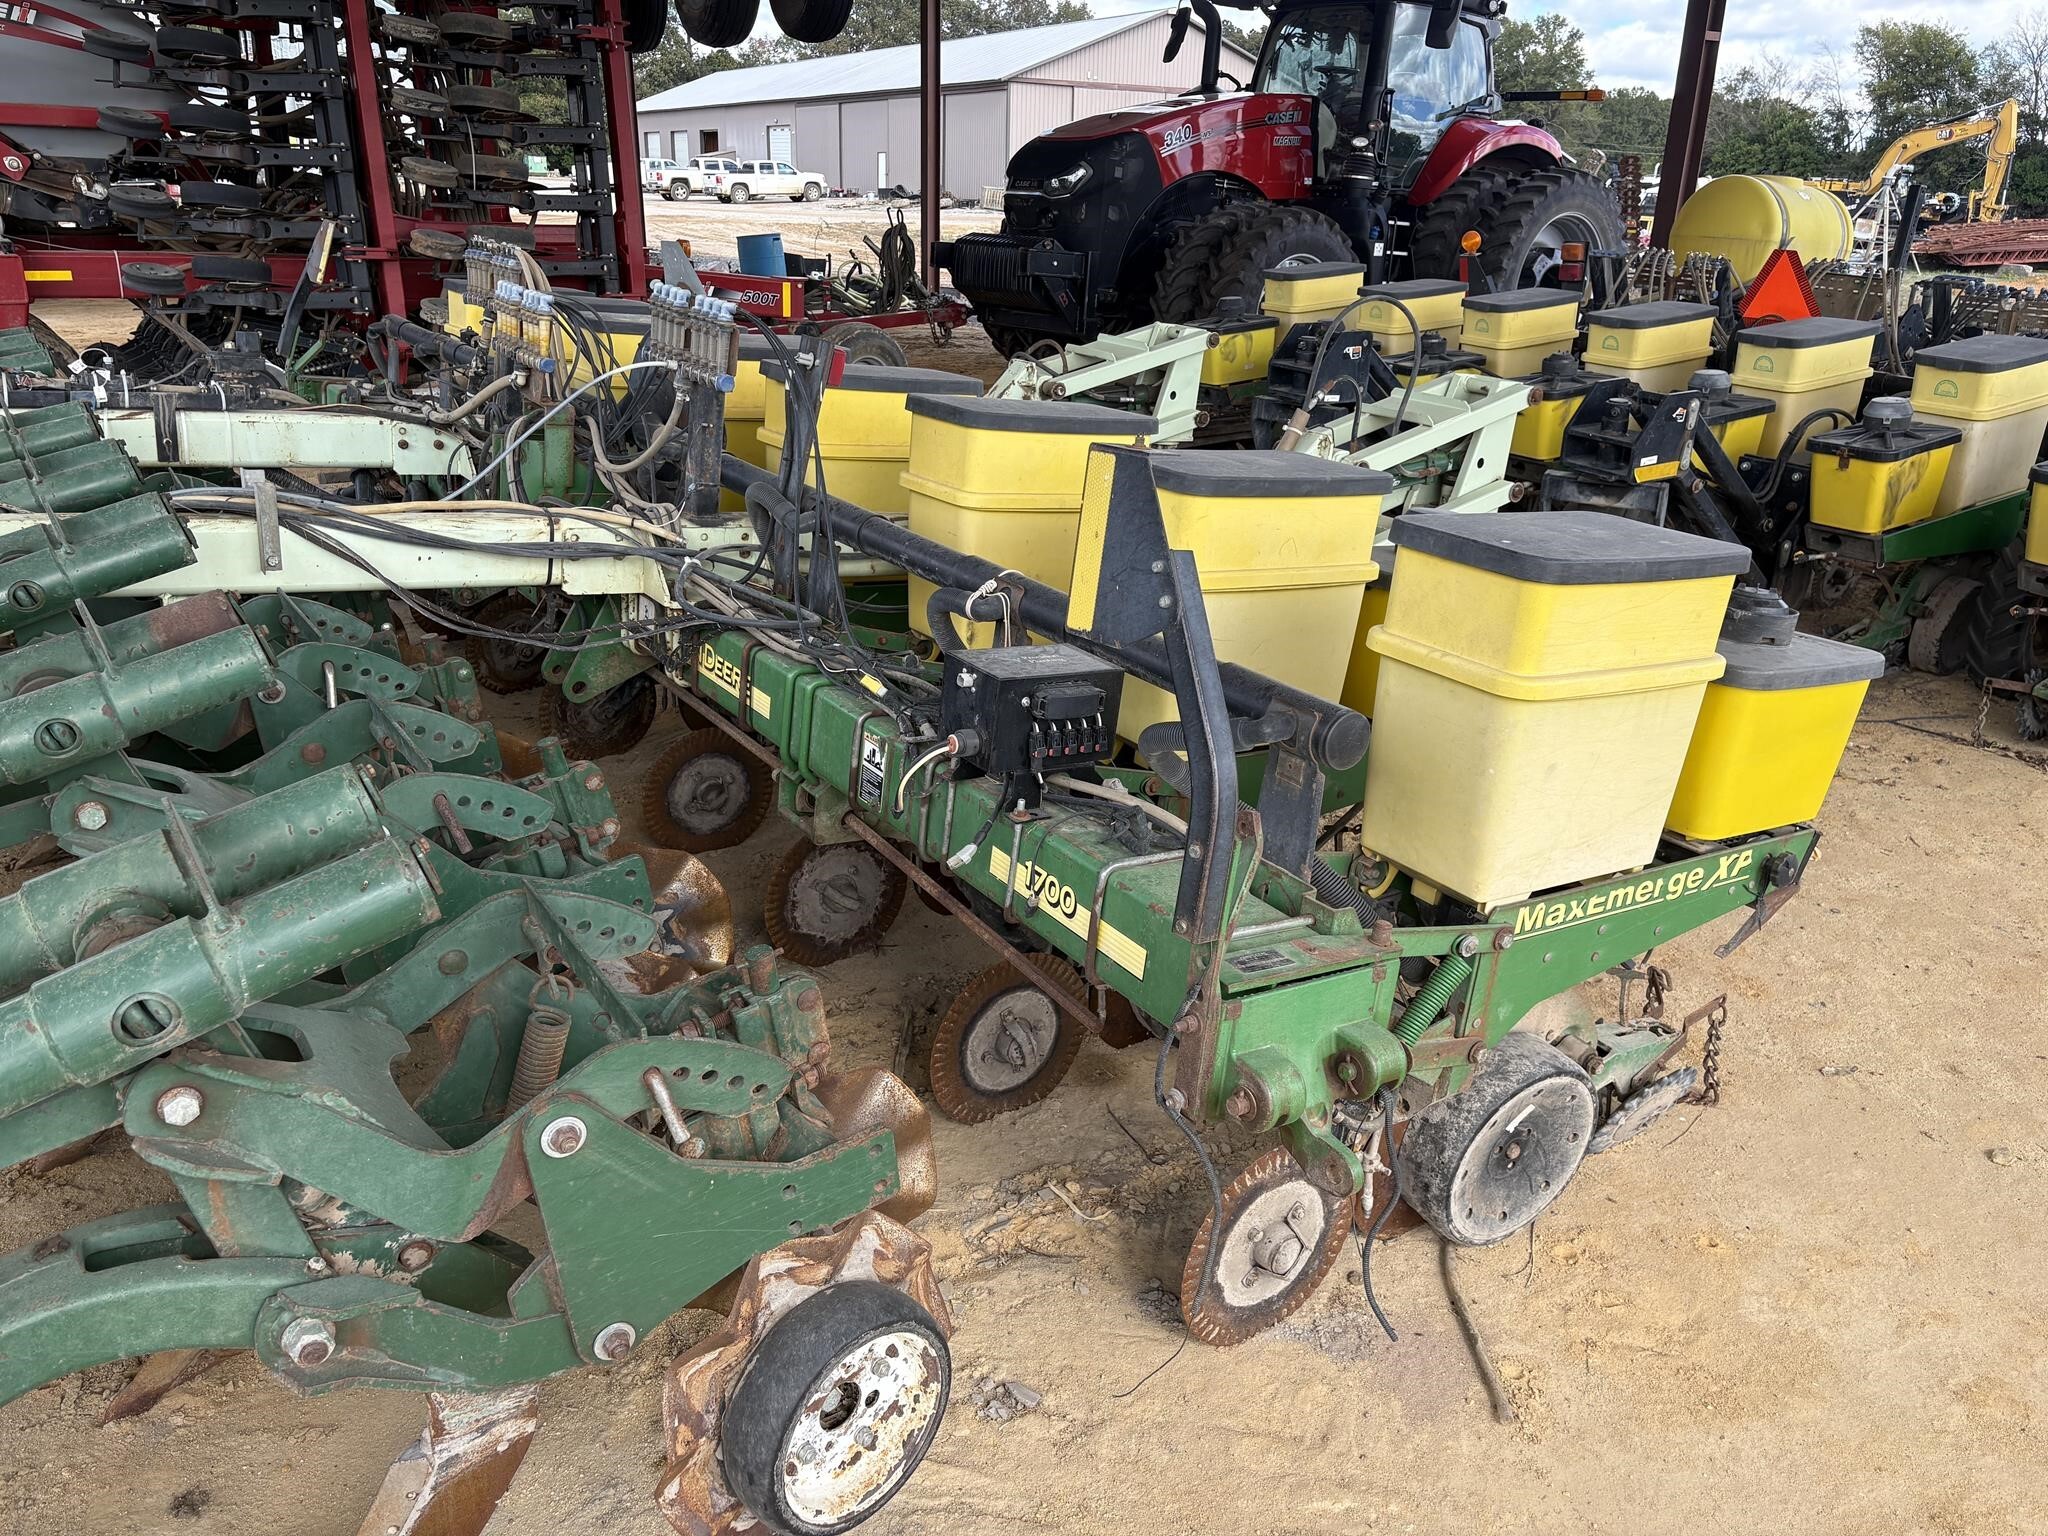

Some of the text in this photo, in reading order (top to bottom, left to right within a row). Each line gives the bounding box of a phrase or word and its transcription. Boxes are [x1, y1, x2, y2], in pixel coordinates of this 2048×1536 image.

[1265, 111, 1294, 125] CASE
[1163, 123, 1192, 148] 340
[1273, 136, 1302, 146] MAGNUM
[1936, 129, 1951, 139] CAT
[742, 290, 780, 306] 500T
[1702, 849, 1753, 891] XP
[1023, 860, 1078, 919] 1700
